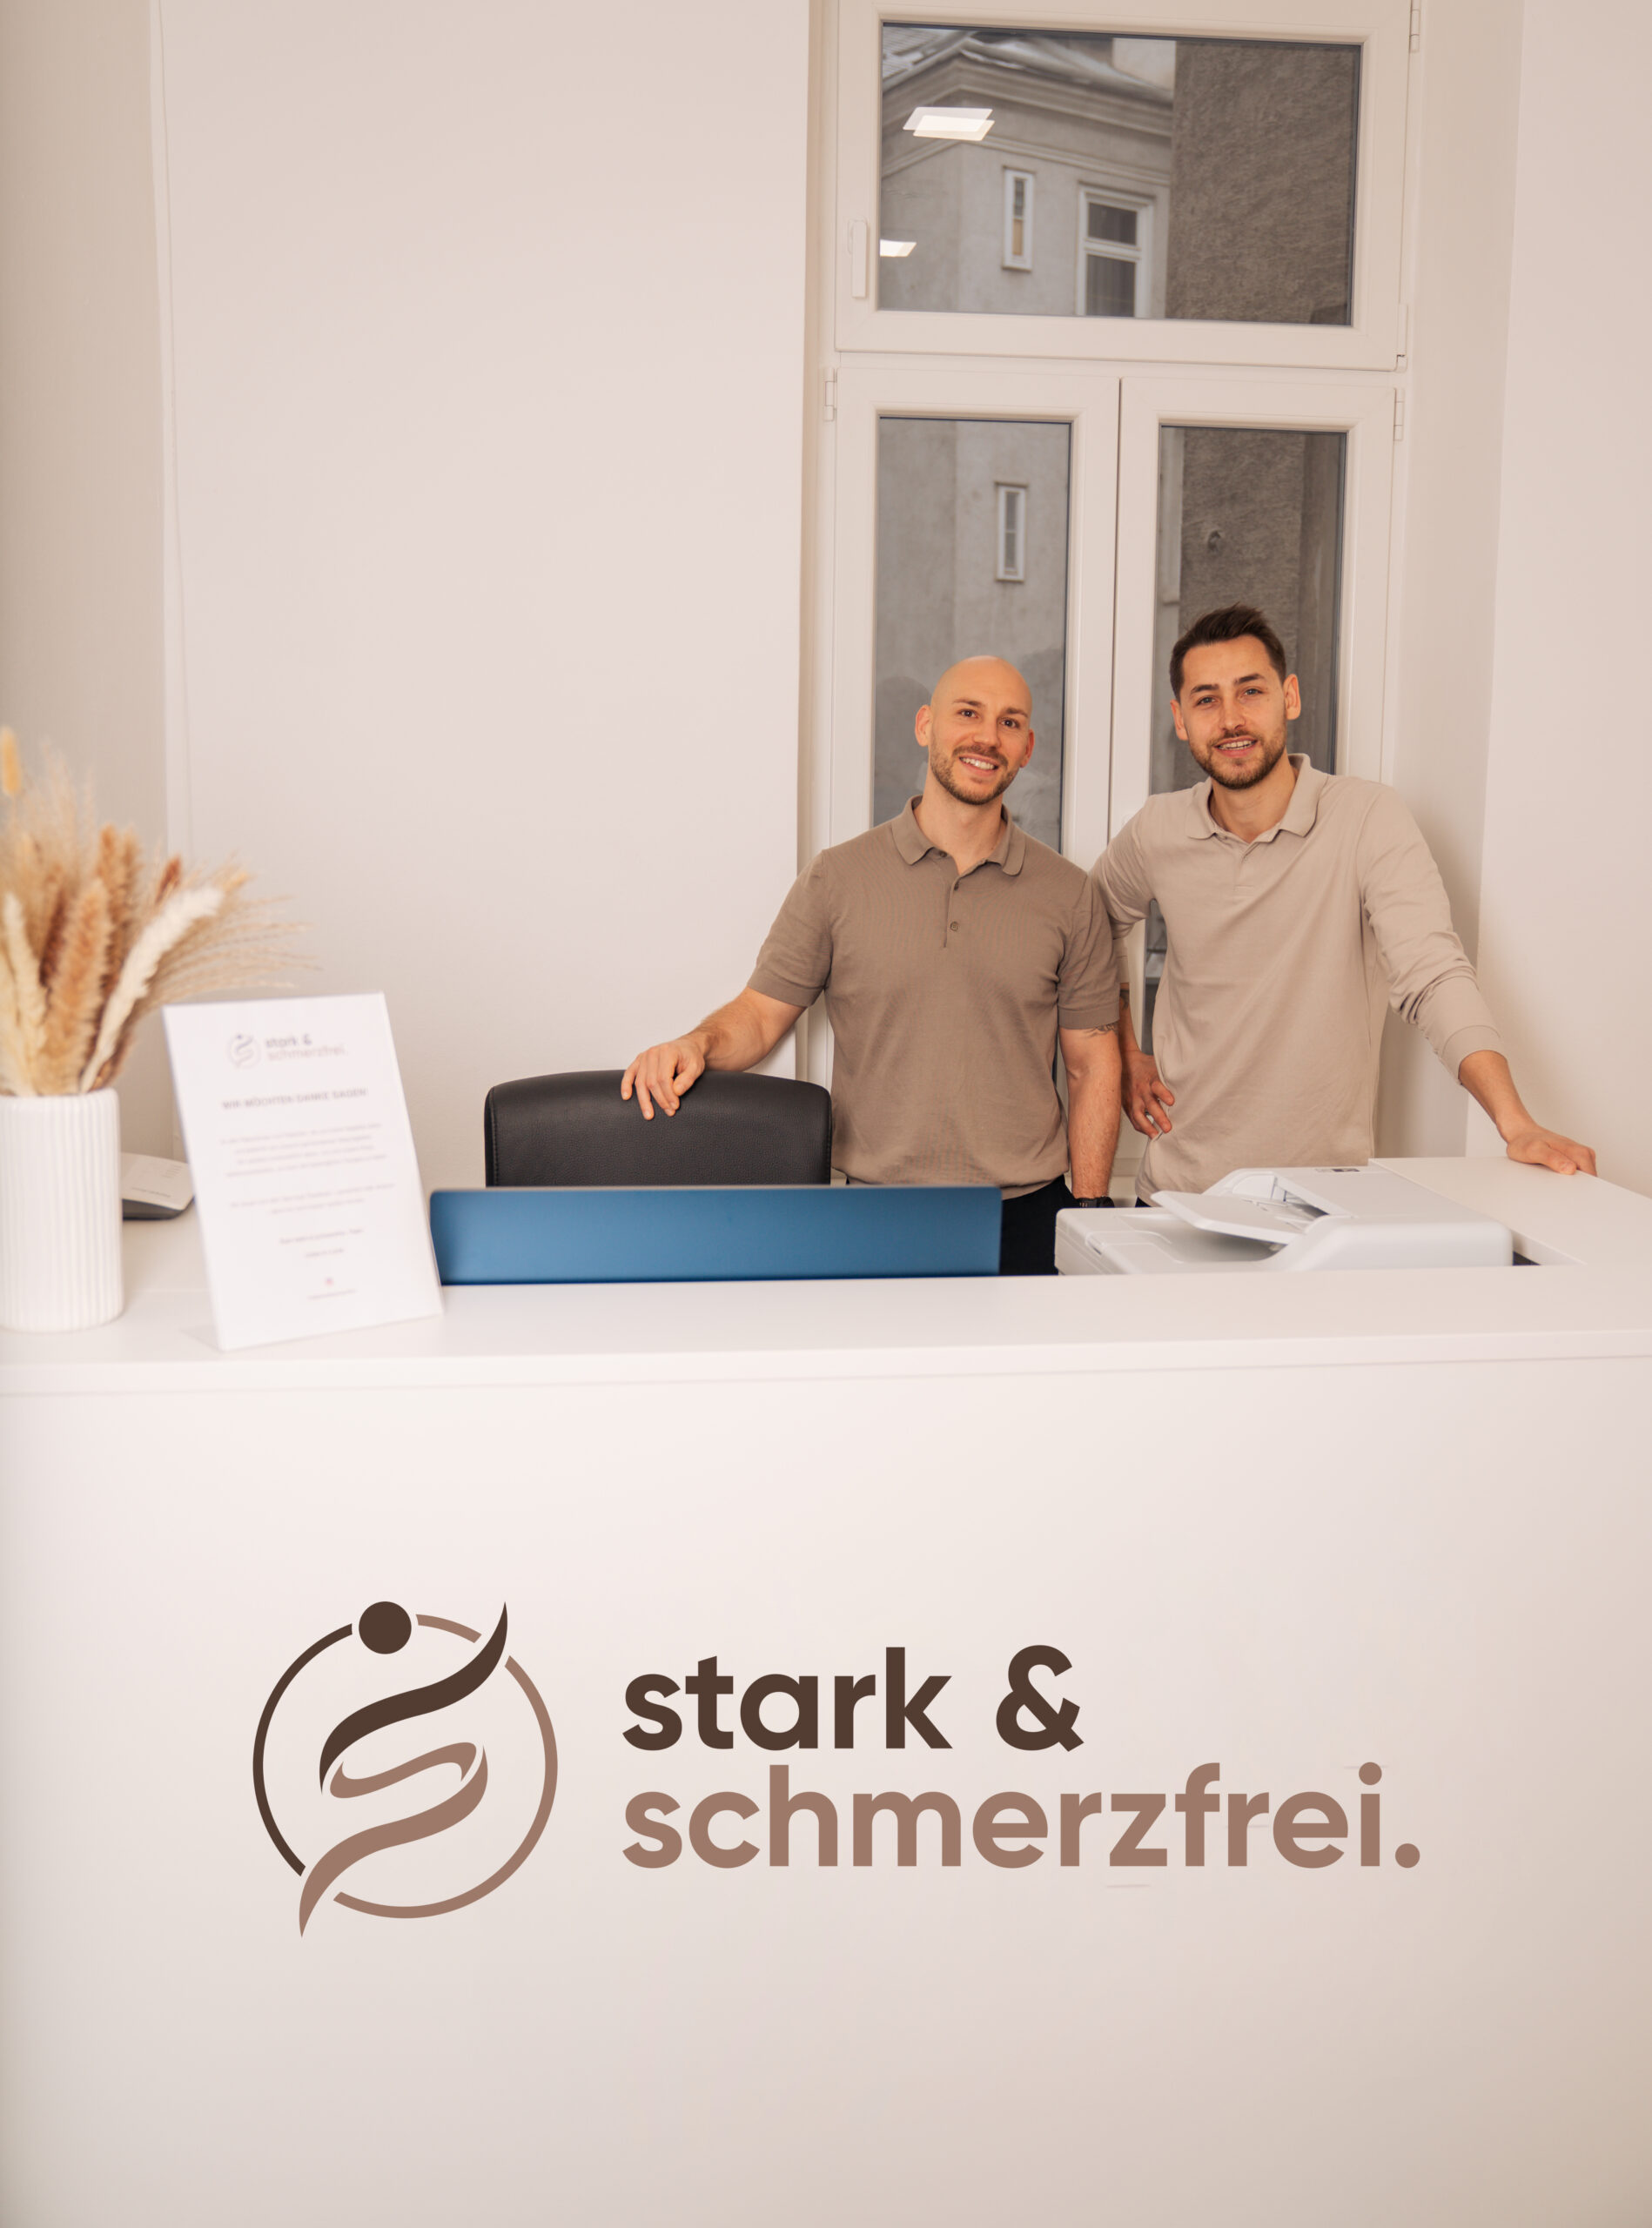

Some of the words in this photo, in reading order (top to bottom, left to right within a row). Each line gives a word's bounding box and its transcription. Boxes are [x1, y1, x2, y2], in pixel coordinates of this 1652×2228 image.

[265, 1034, 298, 1049] stark
[302, 1034, 312, 1046] &
[623, 1647, 952, 1750] stark
[997, 1645, 1084, 1751] &
[623, 1762, 1420, 1868] schmerzfrei.
